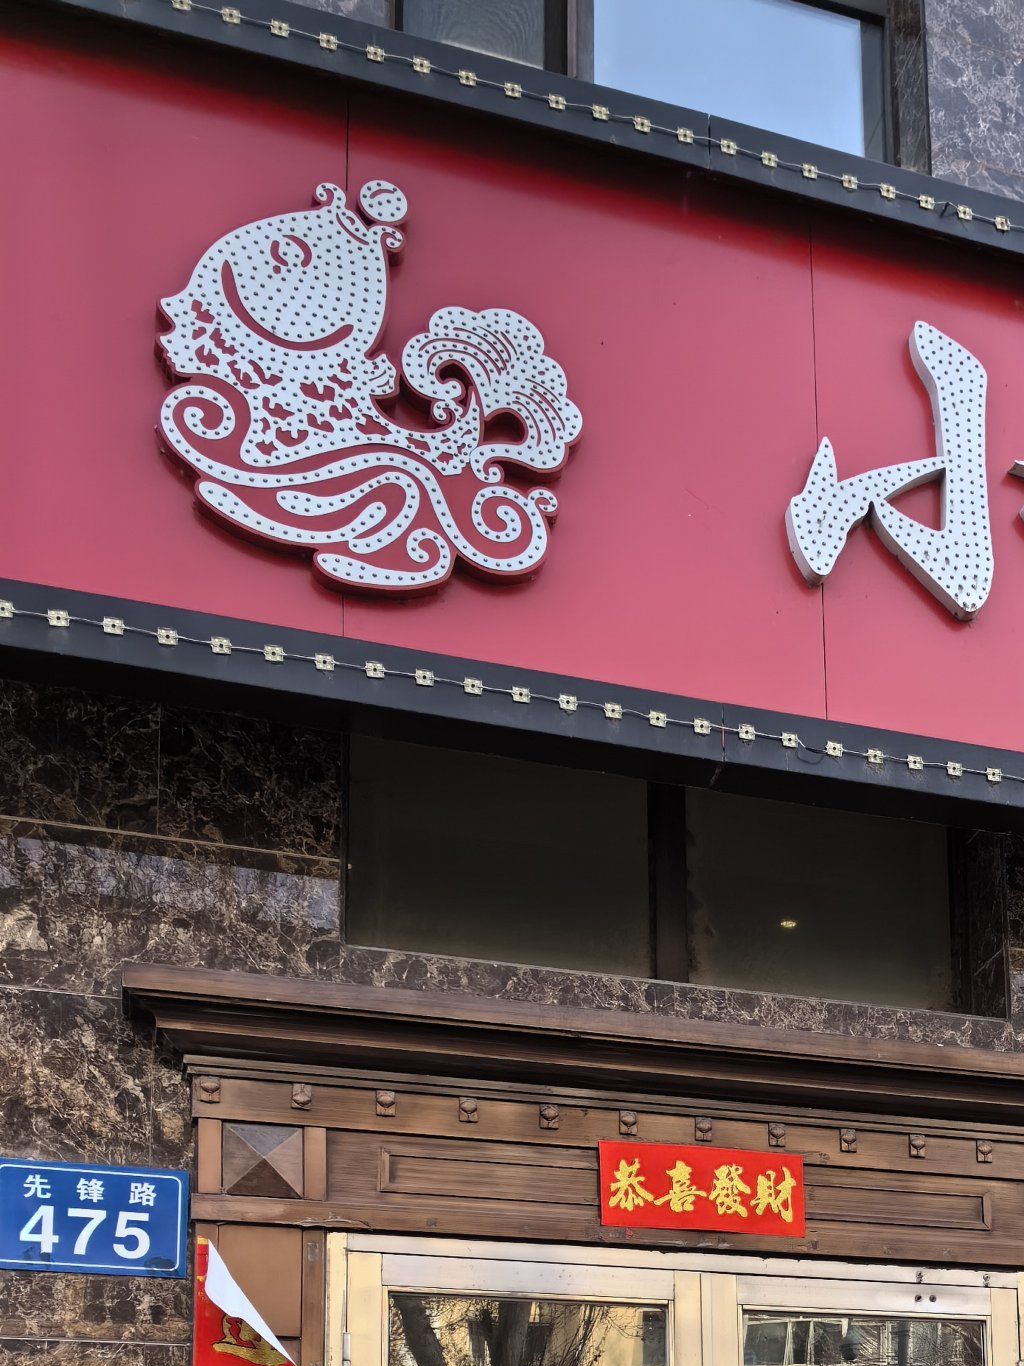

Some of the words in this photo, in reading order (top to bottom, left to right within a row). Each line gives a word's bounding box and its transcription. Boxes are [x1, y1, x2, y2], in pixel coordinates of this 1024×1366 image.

[23, 1174, 157, 1207] 先锋路
[19, 1205, 151, 1259] 475
